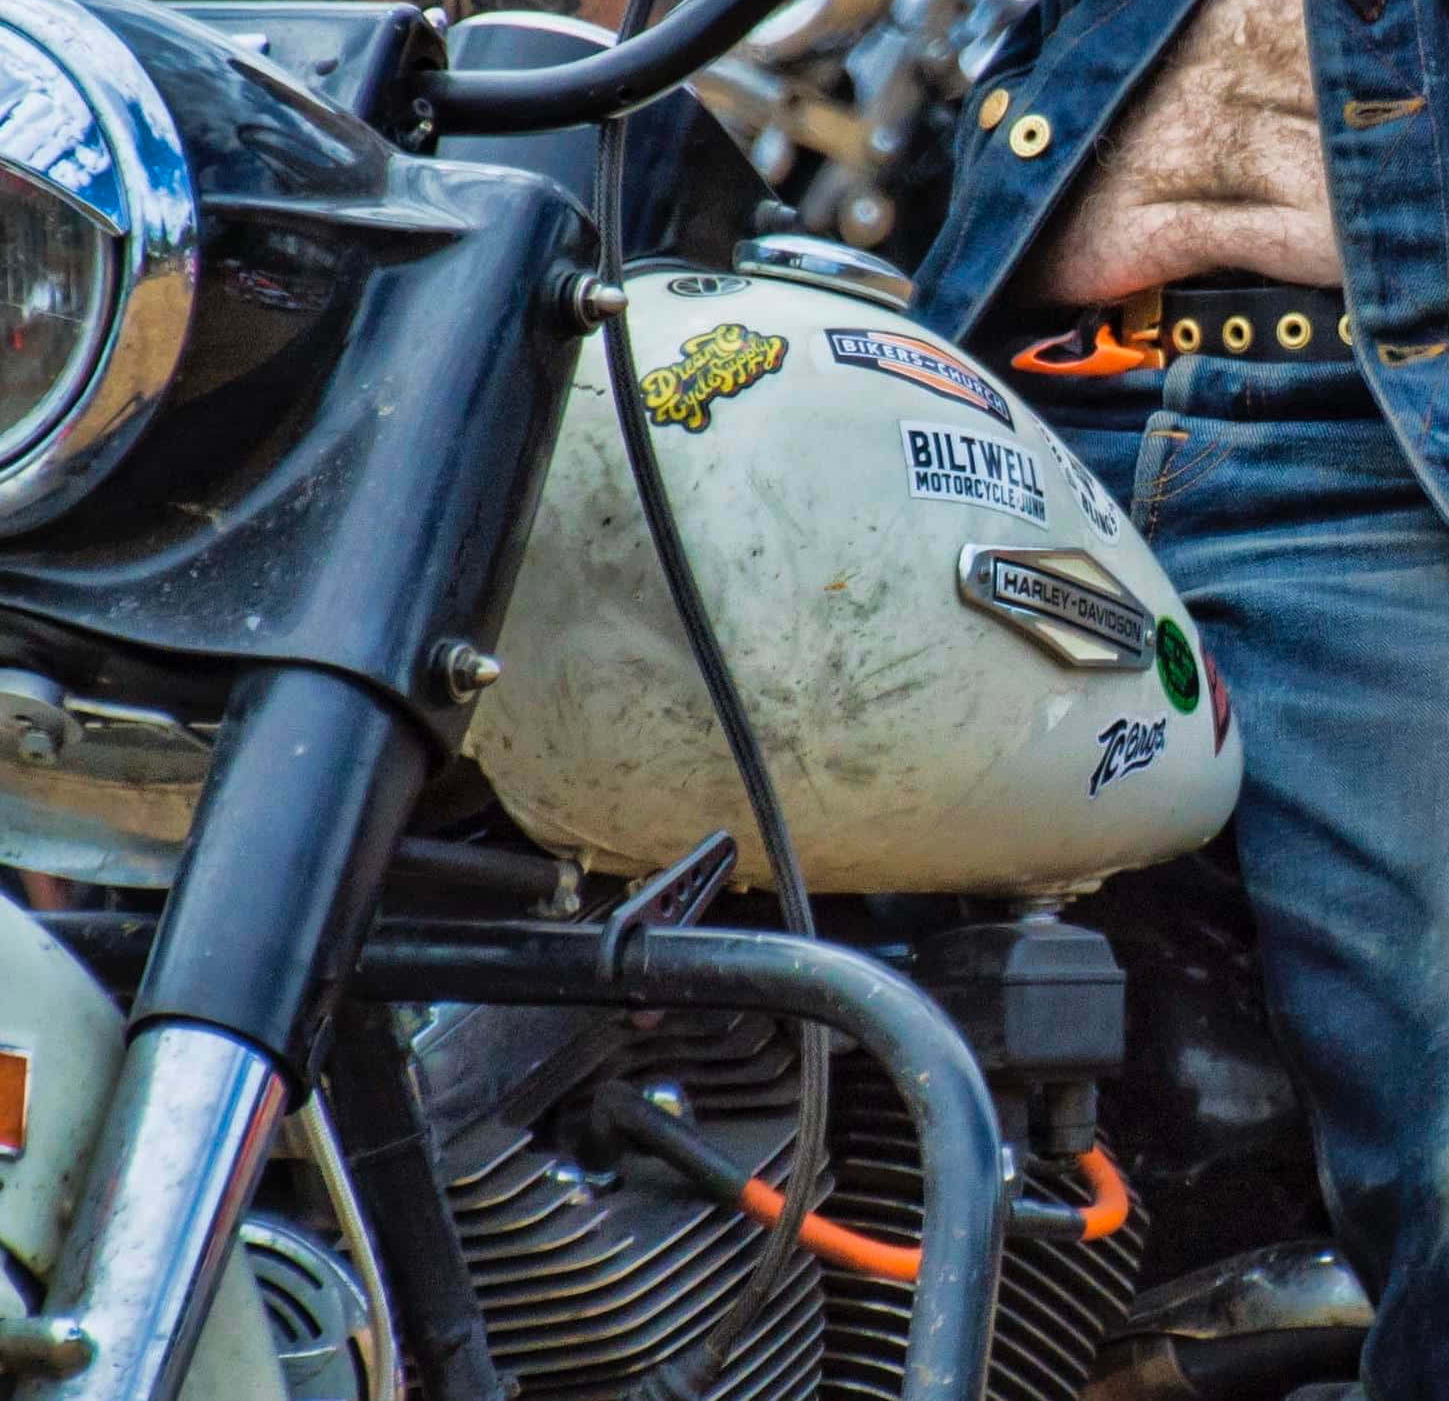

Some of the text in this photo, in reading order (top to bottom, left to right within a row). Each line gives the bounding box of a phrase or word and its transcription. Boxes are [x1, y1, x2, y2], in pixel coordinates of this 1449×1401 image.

[908, 430, 1043, 497] BILTWELL
[915, 471, 1016, 510] MOTORCYCLE
[1004, 572, 1142, 644] HARLEY-DAVIDSON
